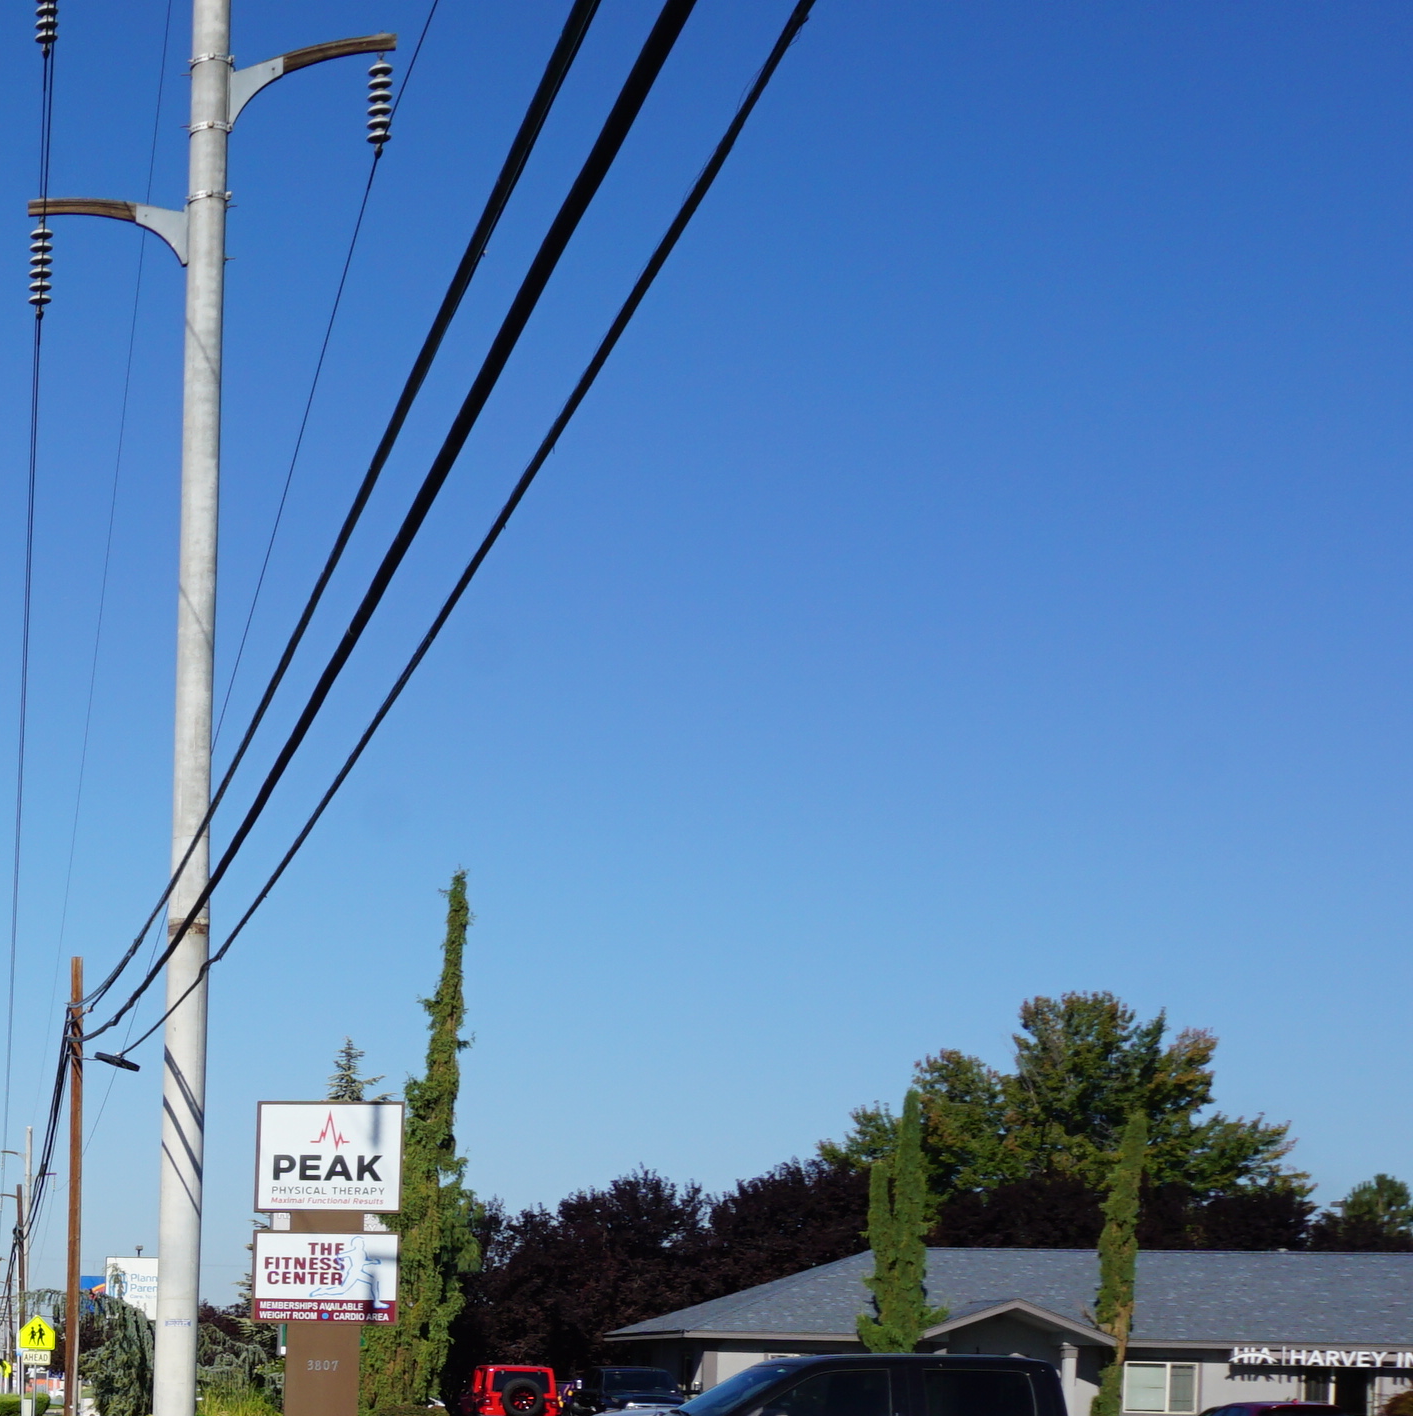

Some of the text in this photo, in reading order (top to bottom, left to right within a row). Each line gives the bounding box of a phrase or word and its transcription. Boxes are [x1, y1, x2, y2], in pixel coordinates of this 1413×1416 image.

[272, 1154, 384, 1182] PEAK
[271, 1185, 385, 1196] PHYSICAL THERAPY
[270, 1196, 384, 1206] Maximal Functional Results
[308, 1242, 345, 1257] THE
[264, 1256, 345, 1271] FITNESS
[130, 1273, 158, 1283] Plann
[267, 1271, 344, 1286] CENTER
[259, 1301, 364, 1312] MEMBERSHIPS AVAILABLE
[259, 1311, 390, 1322] WEIGHT ROOM CARDIO AREA
[24, 1353, 49, 1362] AHEAD
[1289, 1350, 1388, 1367] HARVEY
[307, 1359, 339, 1372] 3807
